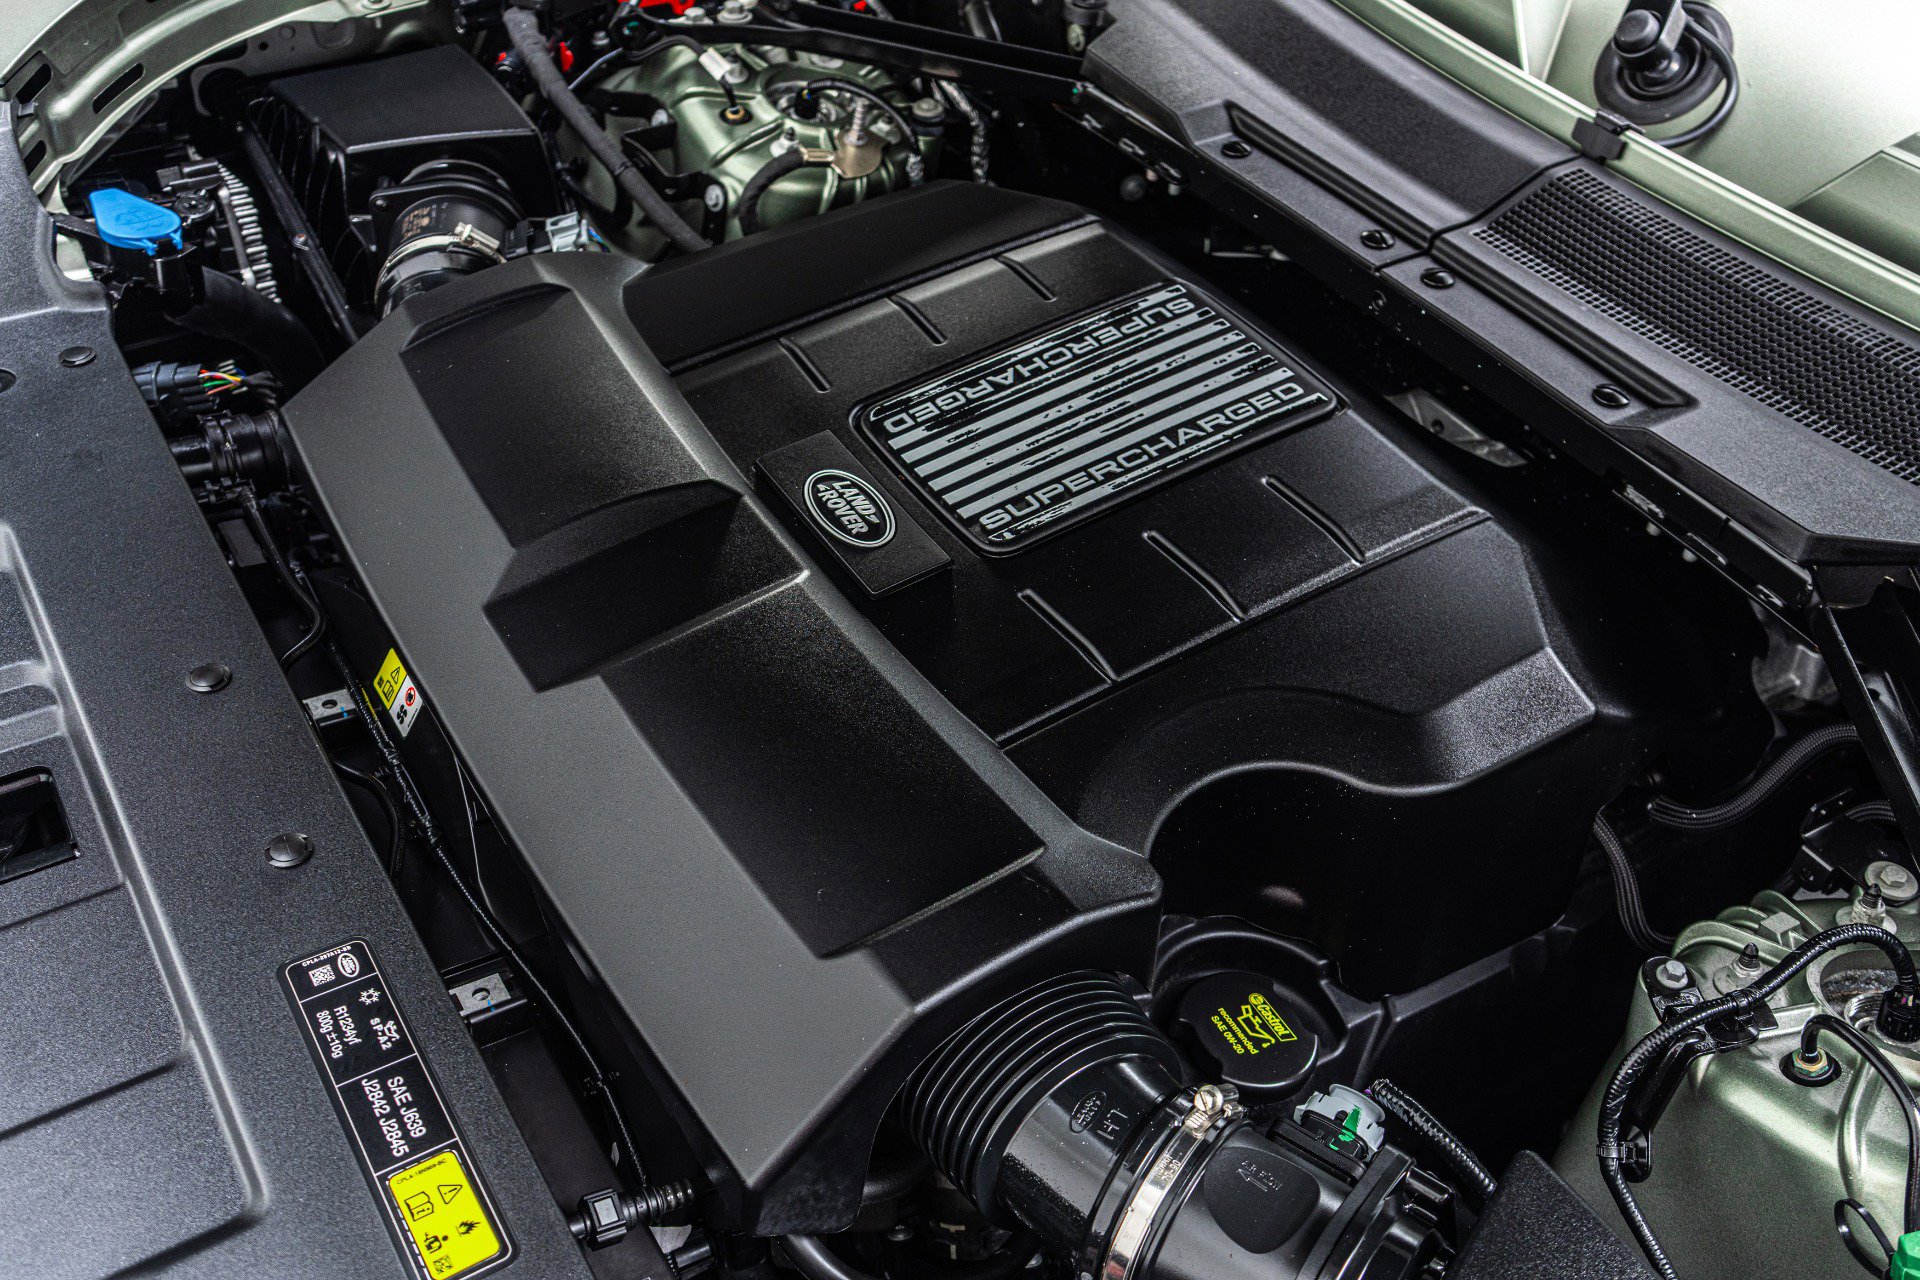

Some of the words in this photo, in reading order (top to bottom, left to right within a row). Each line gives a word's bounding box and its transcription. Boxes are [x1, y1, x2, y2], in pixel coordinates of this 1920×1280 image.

[884, 297, 1196, 435] SUPERCHARGED
[978, 383, 1305, 531] SUPERCHARGED
[817, 489, 869, 535] ROVER
[831, 480, 876, 516] LAND
[316, 1010, 334, 1033] 800g
[333, 1005, 362, 1046] R1234yf
[1211, 1015, 1228, 1032] SAE
[1223, 1031, 1245, 1055] 0W-20
[1218, 1007, 1259, 1055] recommended
[1256, 1004, 1291, 1036] Castrol
[361, 1079, 391, 1117] J2842
[379, 1118, 410, 1157] J2845
[387, 1076, 413, 1107] SAE
[400, 1107, 427, 1138] J639
